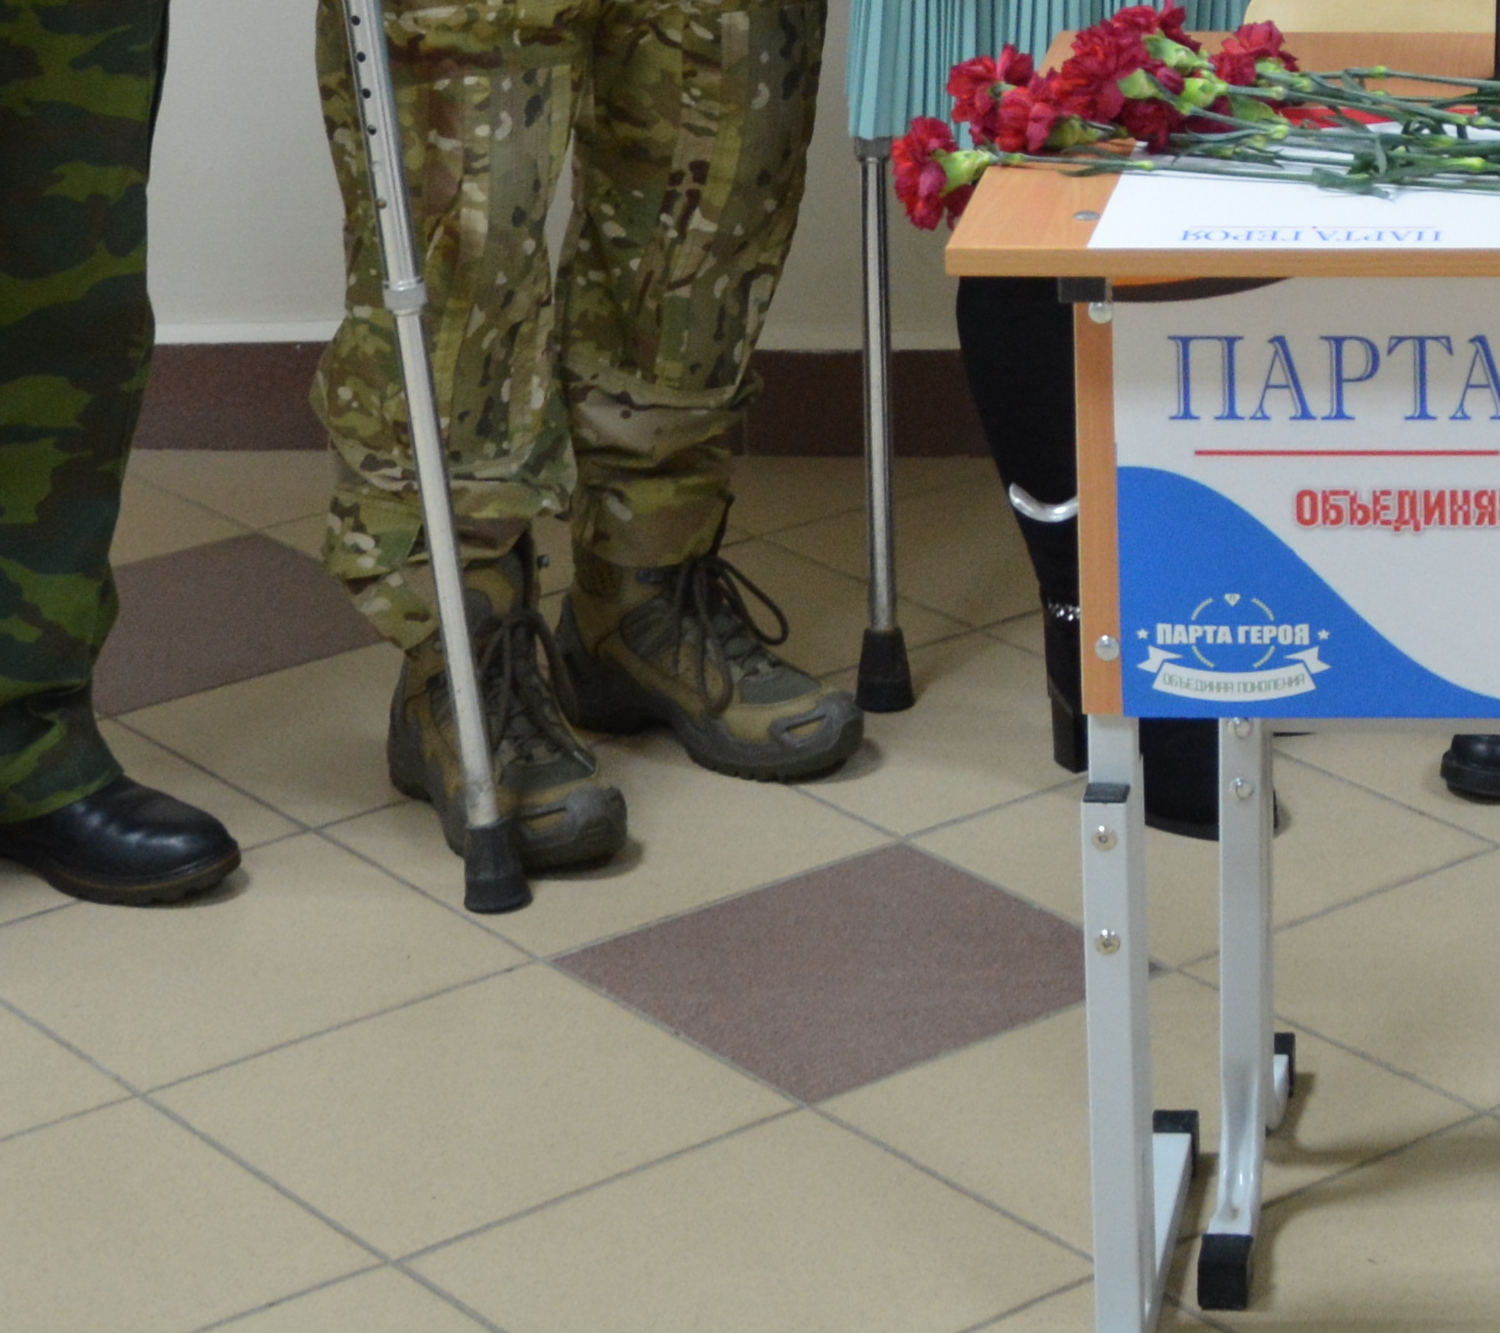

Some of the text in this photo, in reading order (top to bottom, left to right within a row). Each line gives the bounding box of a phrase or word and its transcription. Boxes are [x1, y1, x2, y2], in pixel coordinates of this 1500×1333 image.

[1180, 229, 1443, 242] ПАРТА ГЕРОЯ
[1156, 622, 1311, 646] ПАРТА ГЕРОЯ
